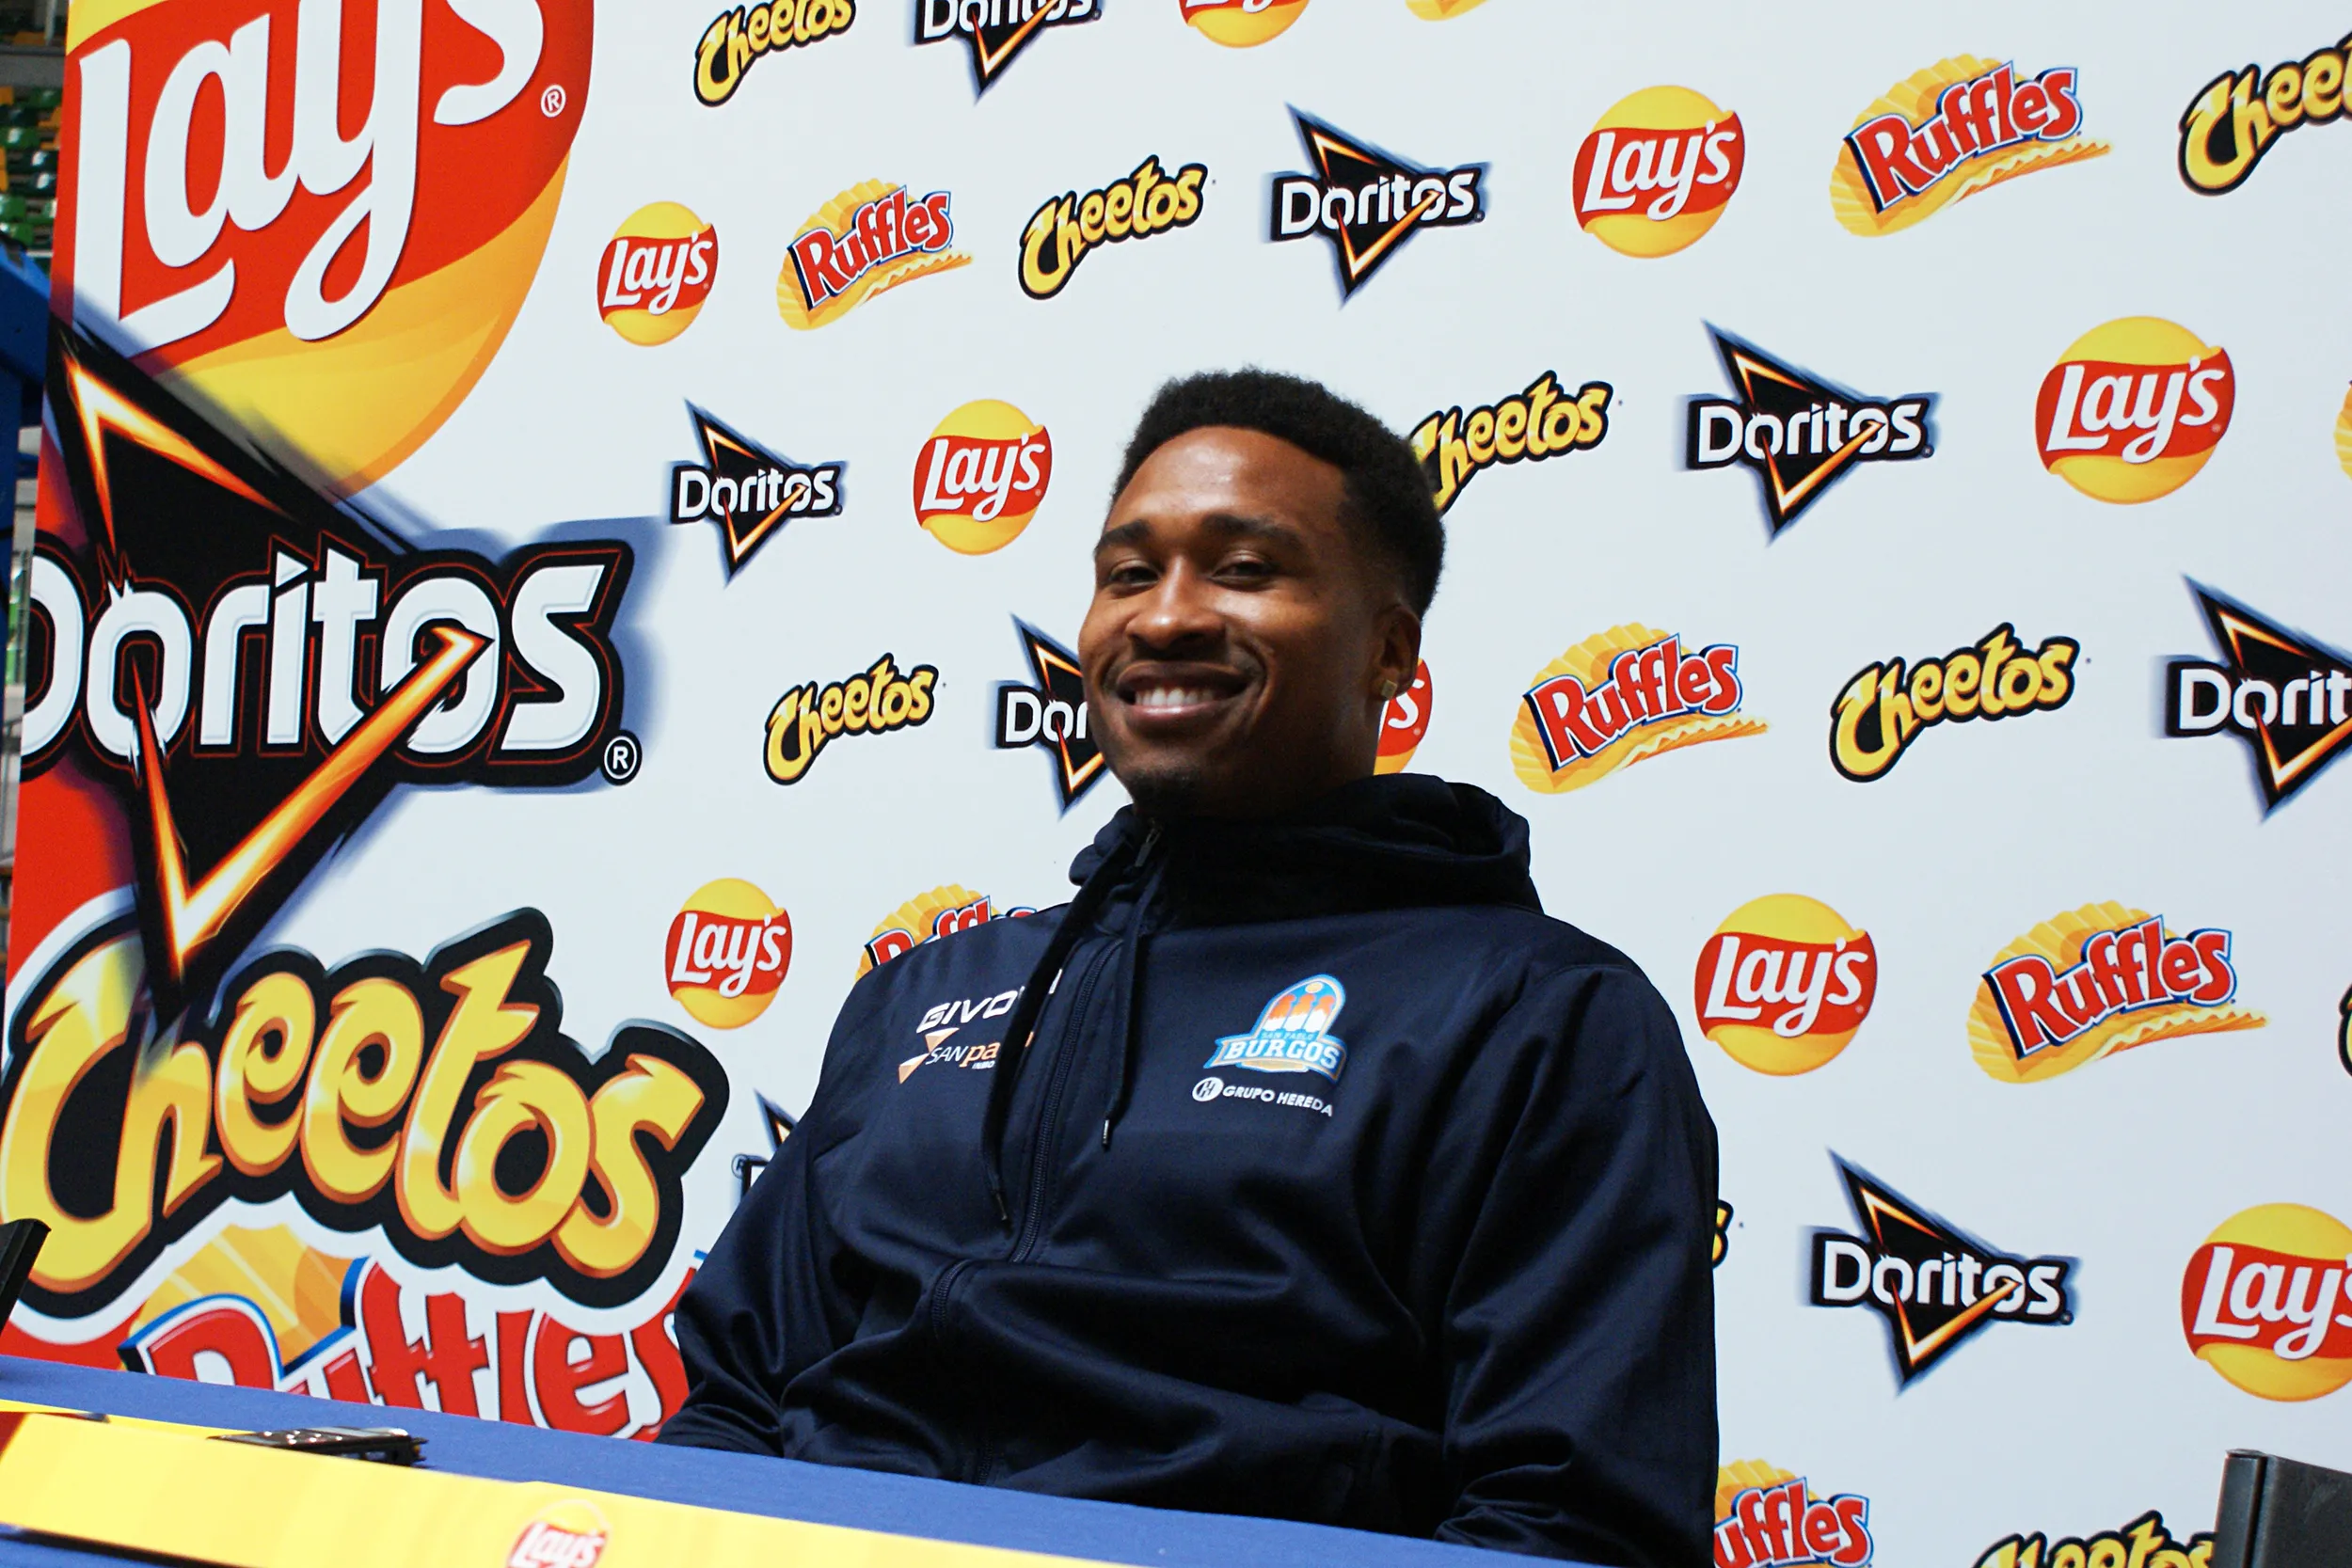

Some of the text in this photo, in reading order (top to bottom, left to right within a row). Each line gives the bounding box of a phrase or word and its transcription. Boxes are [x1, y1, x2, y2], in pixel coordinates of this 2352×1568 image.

[1847, 60, 2082, 214] Ruffles
[2178, 29, 2352, 196] Chee
[1280, 170, 1478, 235] Doritos
[1581, 110, 1737, 221] Lay's
[603, 230, 712, 315] Lay's
[789, 185, 953, 310] Ruffles
[1020, 157, 1207, 298] Cheetos
[1697, 403, 1921, 463] Doritos
[2045, 355, 2226, 464] Lay's
[677, 469, 835, 518] Doritos
[921, 432, 1047, 522] Lay's
[764, 654, 939, 784] Cheetos
[1005, 690, 1089, 749] Dor
[1523, 633, 1742, 771] Ruffles
[1831, 624, 2079, 781] Cheetos
[671, 913, 787, 999] Lay's
[916, 968, 1063, 1034] GIVO
[1703, 936, 1868, 1037] Lay's
[1983, 914, 2237, 1060] Ruffles
[1222, 1085, 1276, 1102] GRUPO
[1276, 1092, 1333, 1117] HEREDA
[1224, 1038, 1340, 1069] BURGOS
[1, 931, 706, 1296] Cheetos
[1822, 1240, 2061, 1316] Doritos
[1714, 1477, 1873, 1568] uffles
